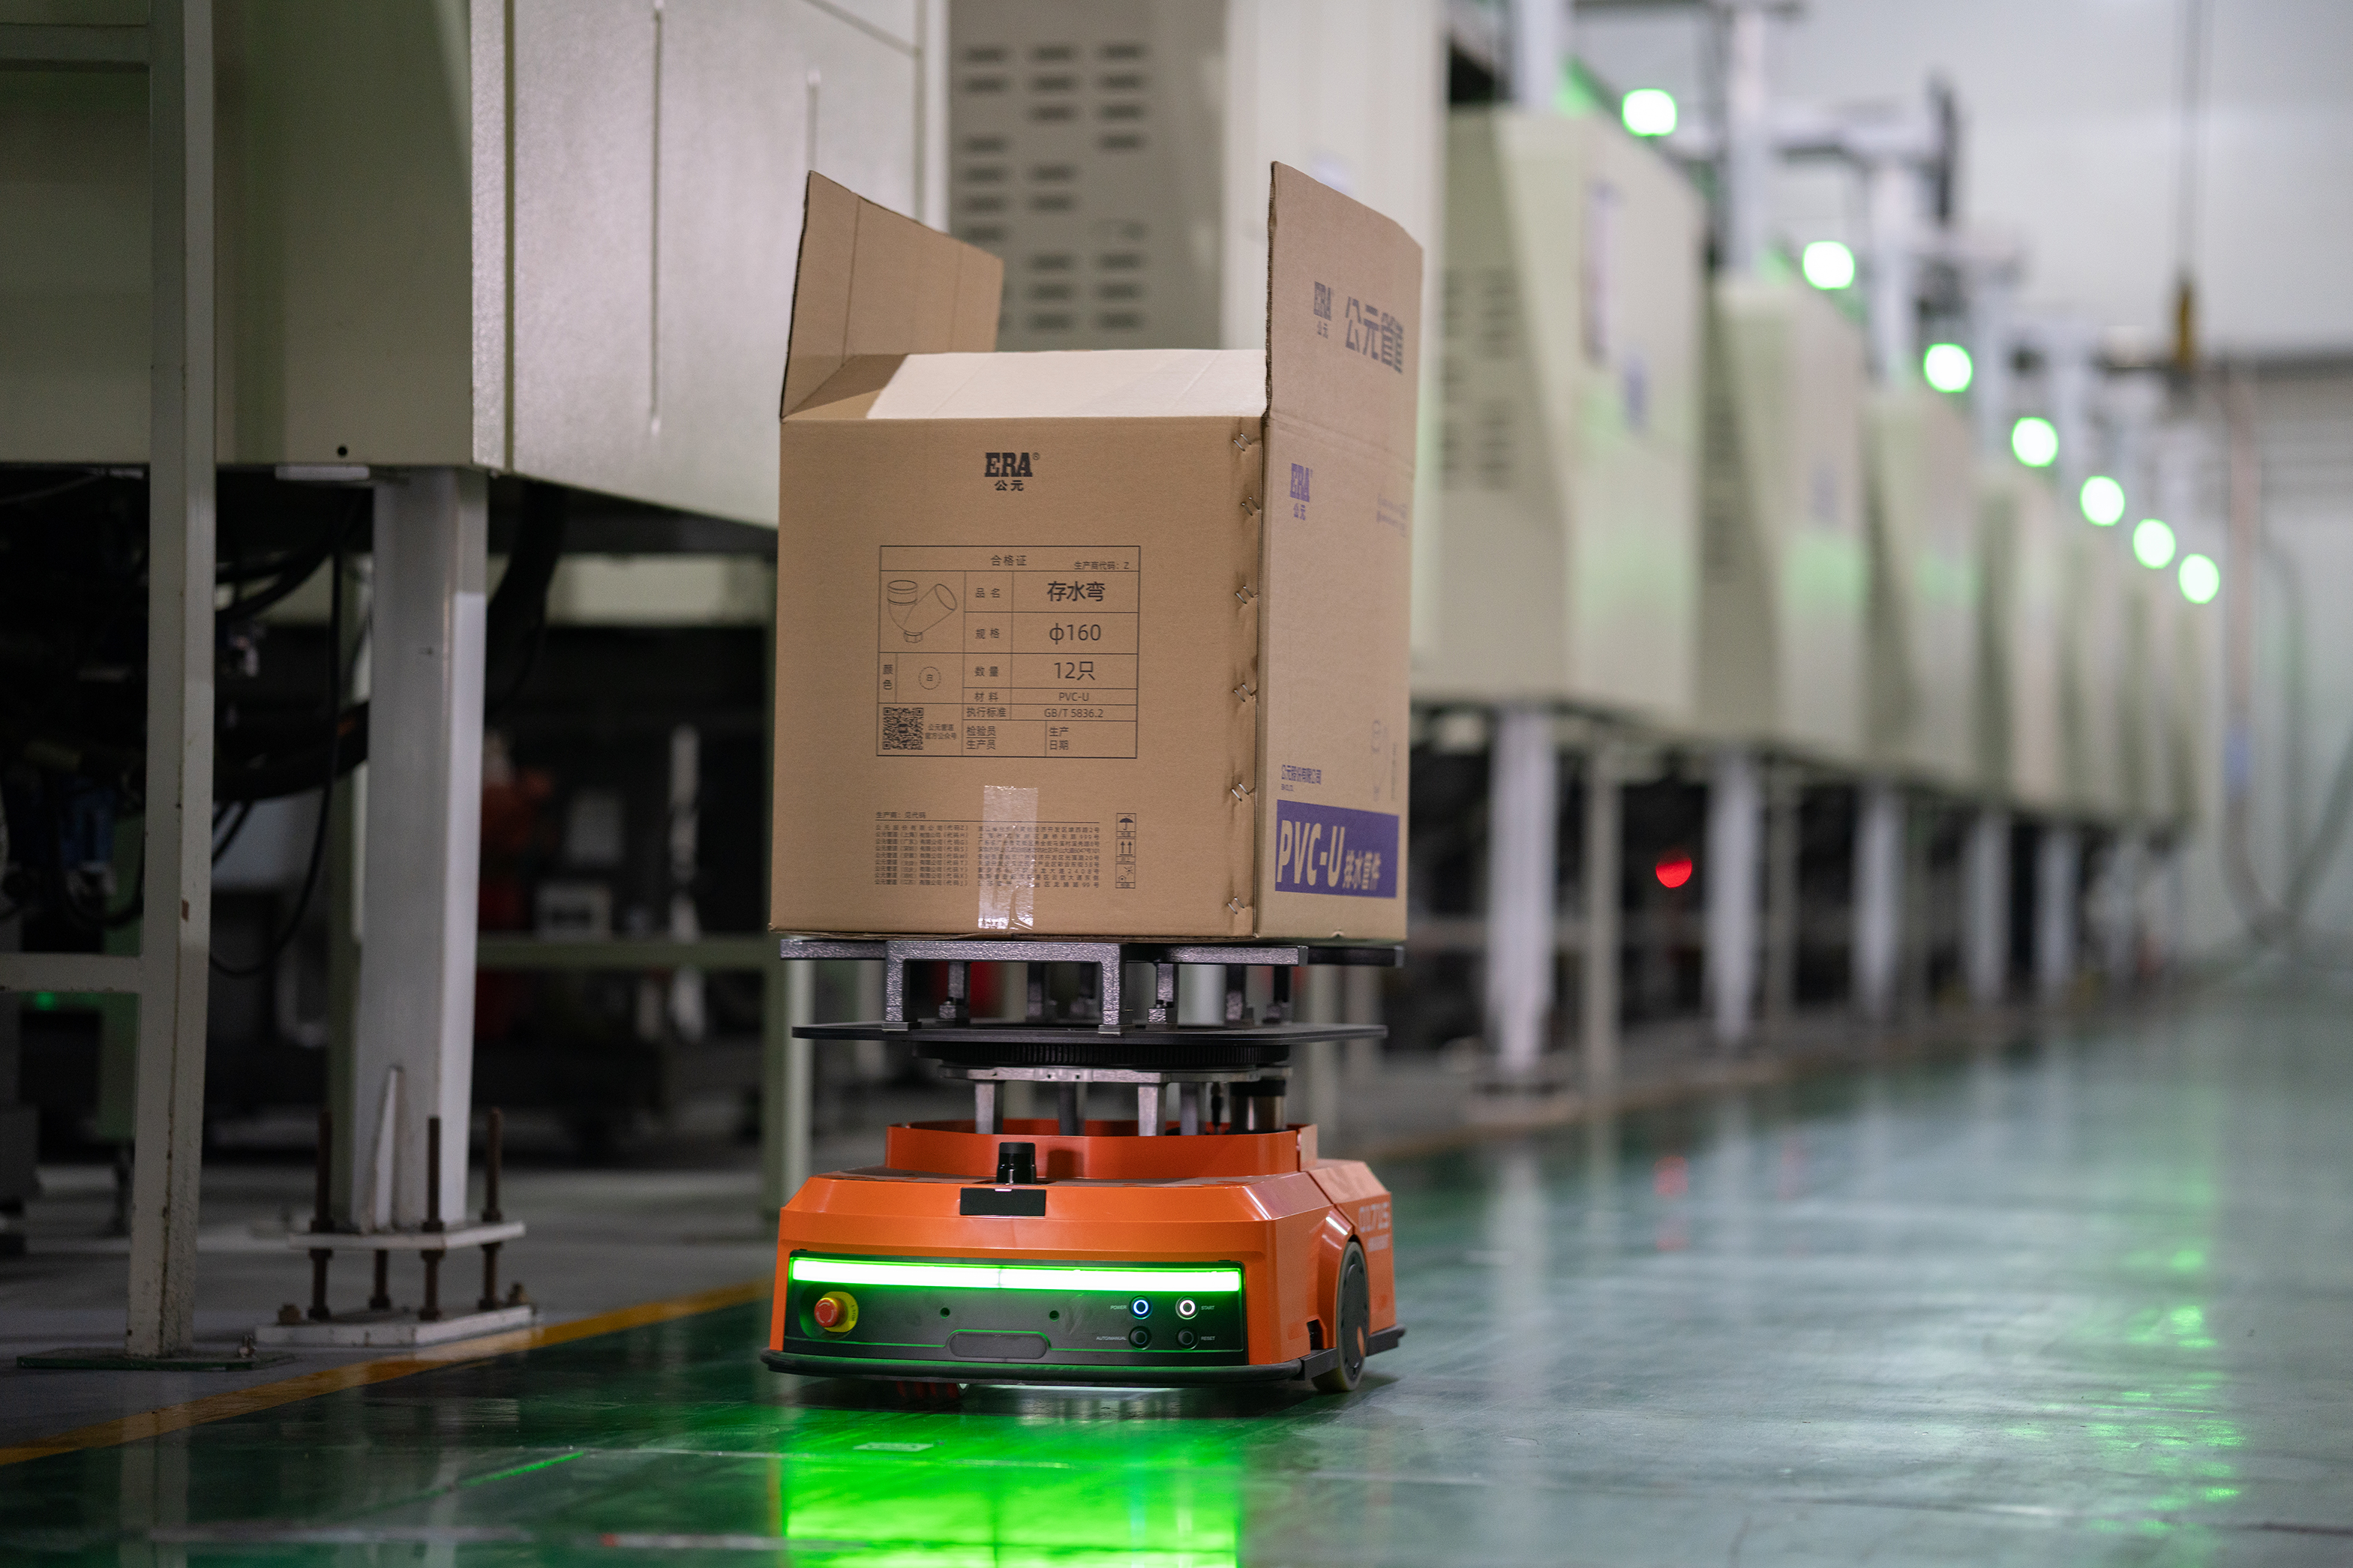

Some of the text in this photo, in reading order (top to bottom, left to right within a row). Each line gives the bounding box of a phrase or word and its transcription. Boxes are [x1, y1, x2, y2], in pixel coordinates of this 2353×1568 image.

[984, 452, 1033, 477] ERA
[994, 479, 1025, 491] 公元
[1289, 463, 1310, 502] ERA
[990, 554, 1027, 566] 合格证
[975, 587, 1000, 598] 品名
[1046, 580, 1106, 602] 存水弯
[975, 628, 1000, 640] 规格
[974, 666, 999, 677] 数量
[1054, 661, 1095, 681] 12只
[974, 691, 998, 702] 材料
[1058, 692, 1090, 701] PVC-U
[966, 706, 1007, 718] 执行标准
[1043, 708, 1104, 718] GB/T 5836.2
[966, 725, 996, 736] 检验员
[1049, 727, 1070, 737] 生产
[966, 739, 996, 750] 生产员
[1049, 739, 1070, 751] 日期
[1276, 820, 1346, 888] PVC-U
